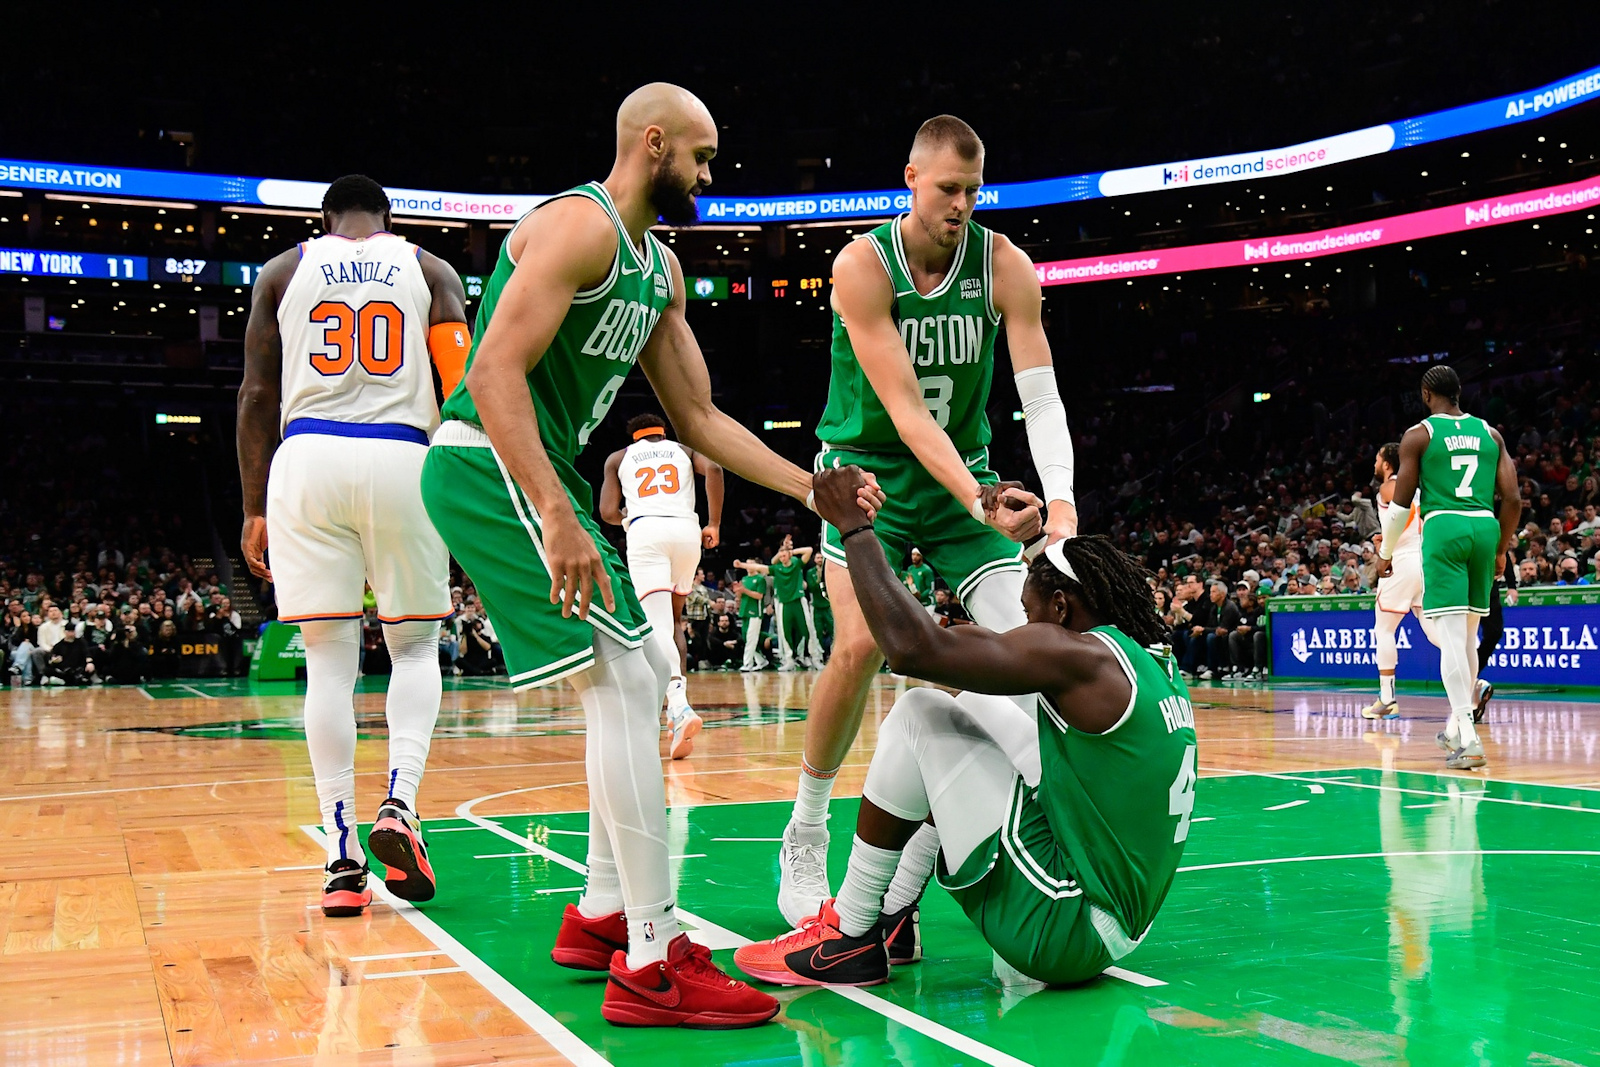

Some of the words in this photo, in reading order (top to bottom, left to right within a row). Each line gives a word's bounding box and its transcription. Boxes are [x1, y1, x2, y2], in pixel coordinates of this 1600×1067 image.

[1504, 73, 1600, 119] AI-POWERED
[1193, 148, 1326, 180] demandscience
[0, 165, 122, 189] GENERATION
[390, 197, 514, 214] mandscience
[707, 200, 817, 217] AI-POWERED
[820, 197, 891, 214] DEMAND
[1491, 186, 1600, 219] demandscienc
[1270, 228, 1382, 256] demandscience
[0, 251, 35, 272] NEW
[39, 253, 84, 275] YORK
[107, 257, 134, 278] 11
[165, 257, 207, 275] 8:37
[240, 265, 260, 285] 1
[320, 261, 401, 287] RANDLE
[1046, 258, 1158, 281] demandscience
[732, 282, 746, 293] 24
[959, 278, 982, 291] VISTA
[960, 288, 982, 300] PRINT
[309, 300, 405, 376] 30
[581, 298, 662, 366] BOSTO
[899, 314, 983, 367] OSTON
[1443, 435, 1481, 452] BROWN
[631, 450, 675, 464] ROBINSON
[635, 463, 681, 498] 23
[1451, 454, 1479, 498] 7
[1308, 626, 1412, 649] ARBELA
[1476, 624, 1598, 650] BELLA
[1320, 652, 1398, 665] INSURAN
[1487, 653, 1581, 668] NSURANCE
[1168, 744, 1197, 844] 4
